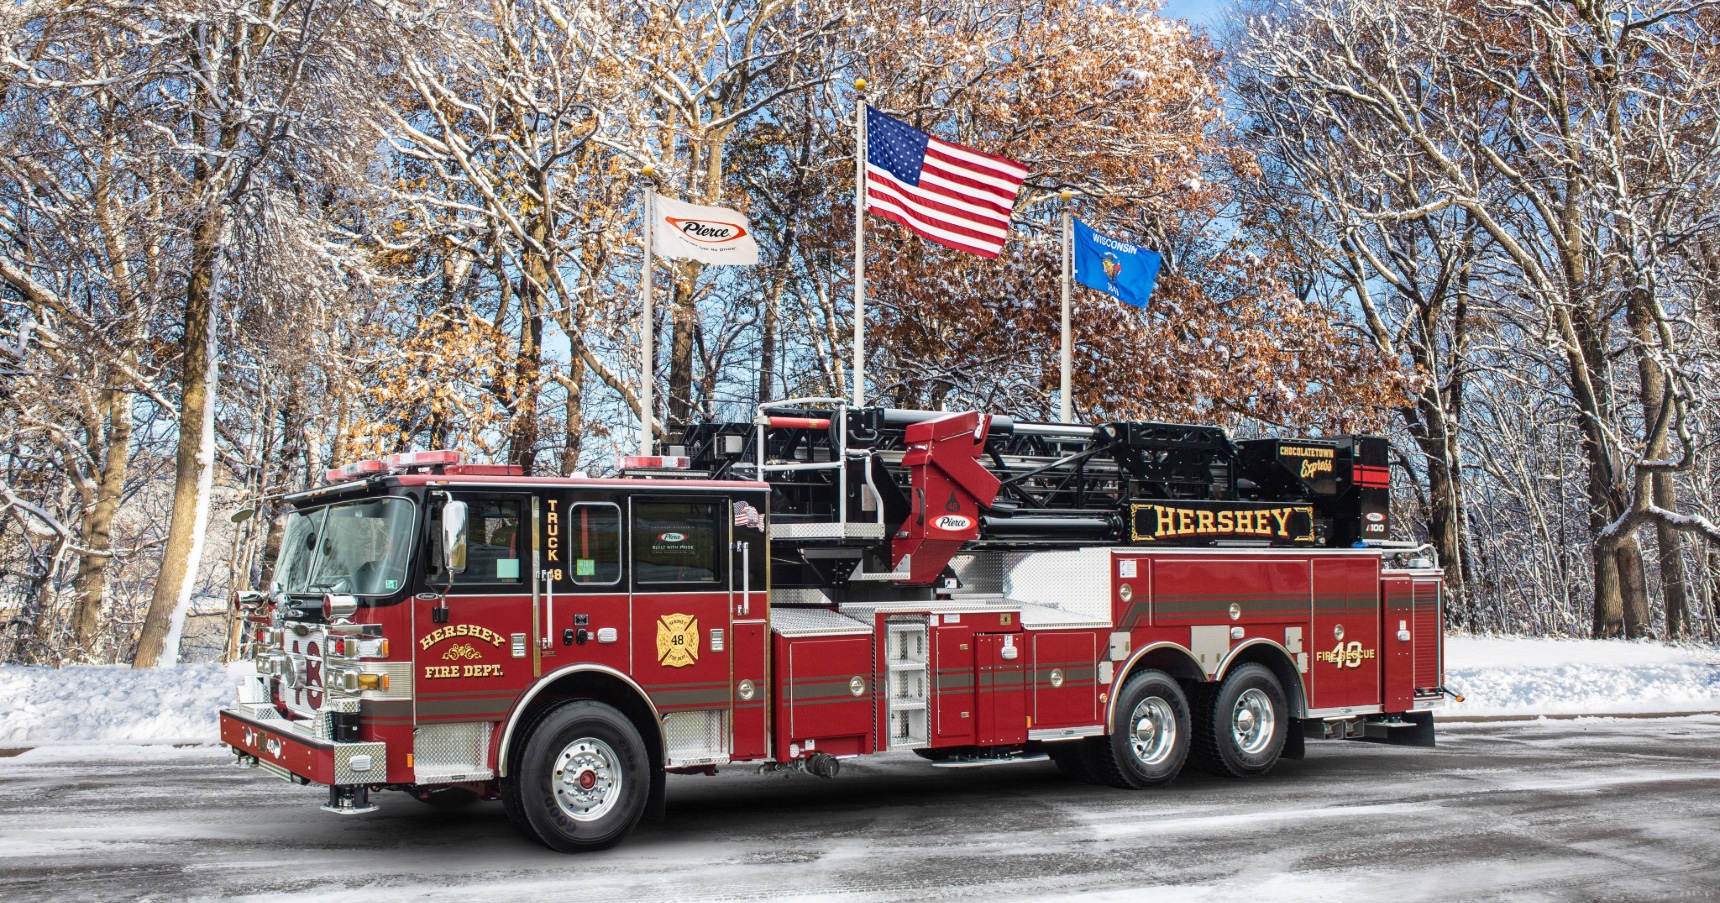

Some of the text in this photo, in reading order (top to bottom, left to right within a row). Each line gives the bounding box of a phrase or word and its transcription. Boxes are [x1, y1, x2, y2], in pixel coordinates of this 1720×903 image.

[683, 221, 730, 238] Pierce
[1092, 232, 1138, 255] WISCONSIN
[1280, 446, 1334, 458] CHOCOLATETOWN
[1300, 459, 1332, 478] Express
[547, 499, 559, 561] TRUCK
[940, 516, 966, 528] Pierce
[1153, 504, 1293, 539] HERSHEY
[419, 624, 506, 651] HERSHEY
[671, 634, 684, 646] 48
[1316, 648, 1375, 661] FIRE RESCUE
[425, 664, 504, 679] FIRE DEPT.
